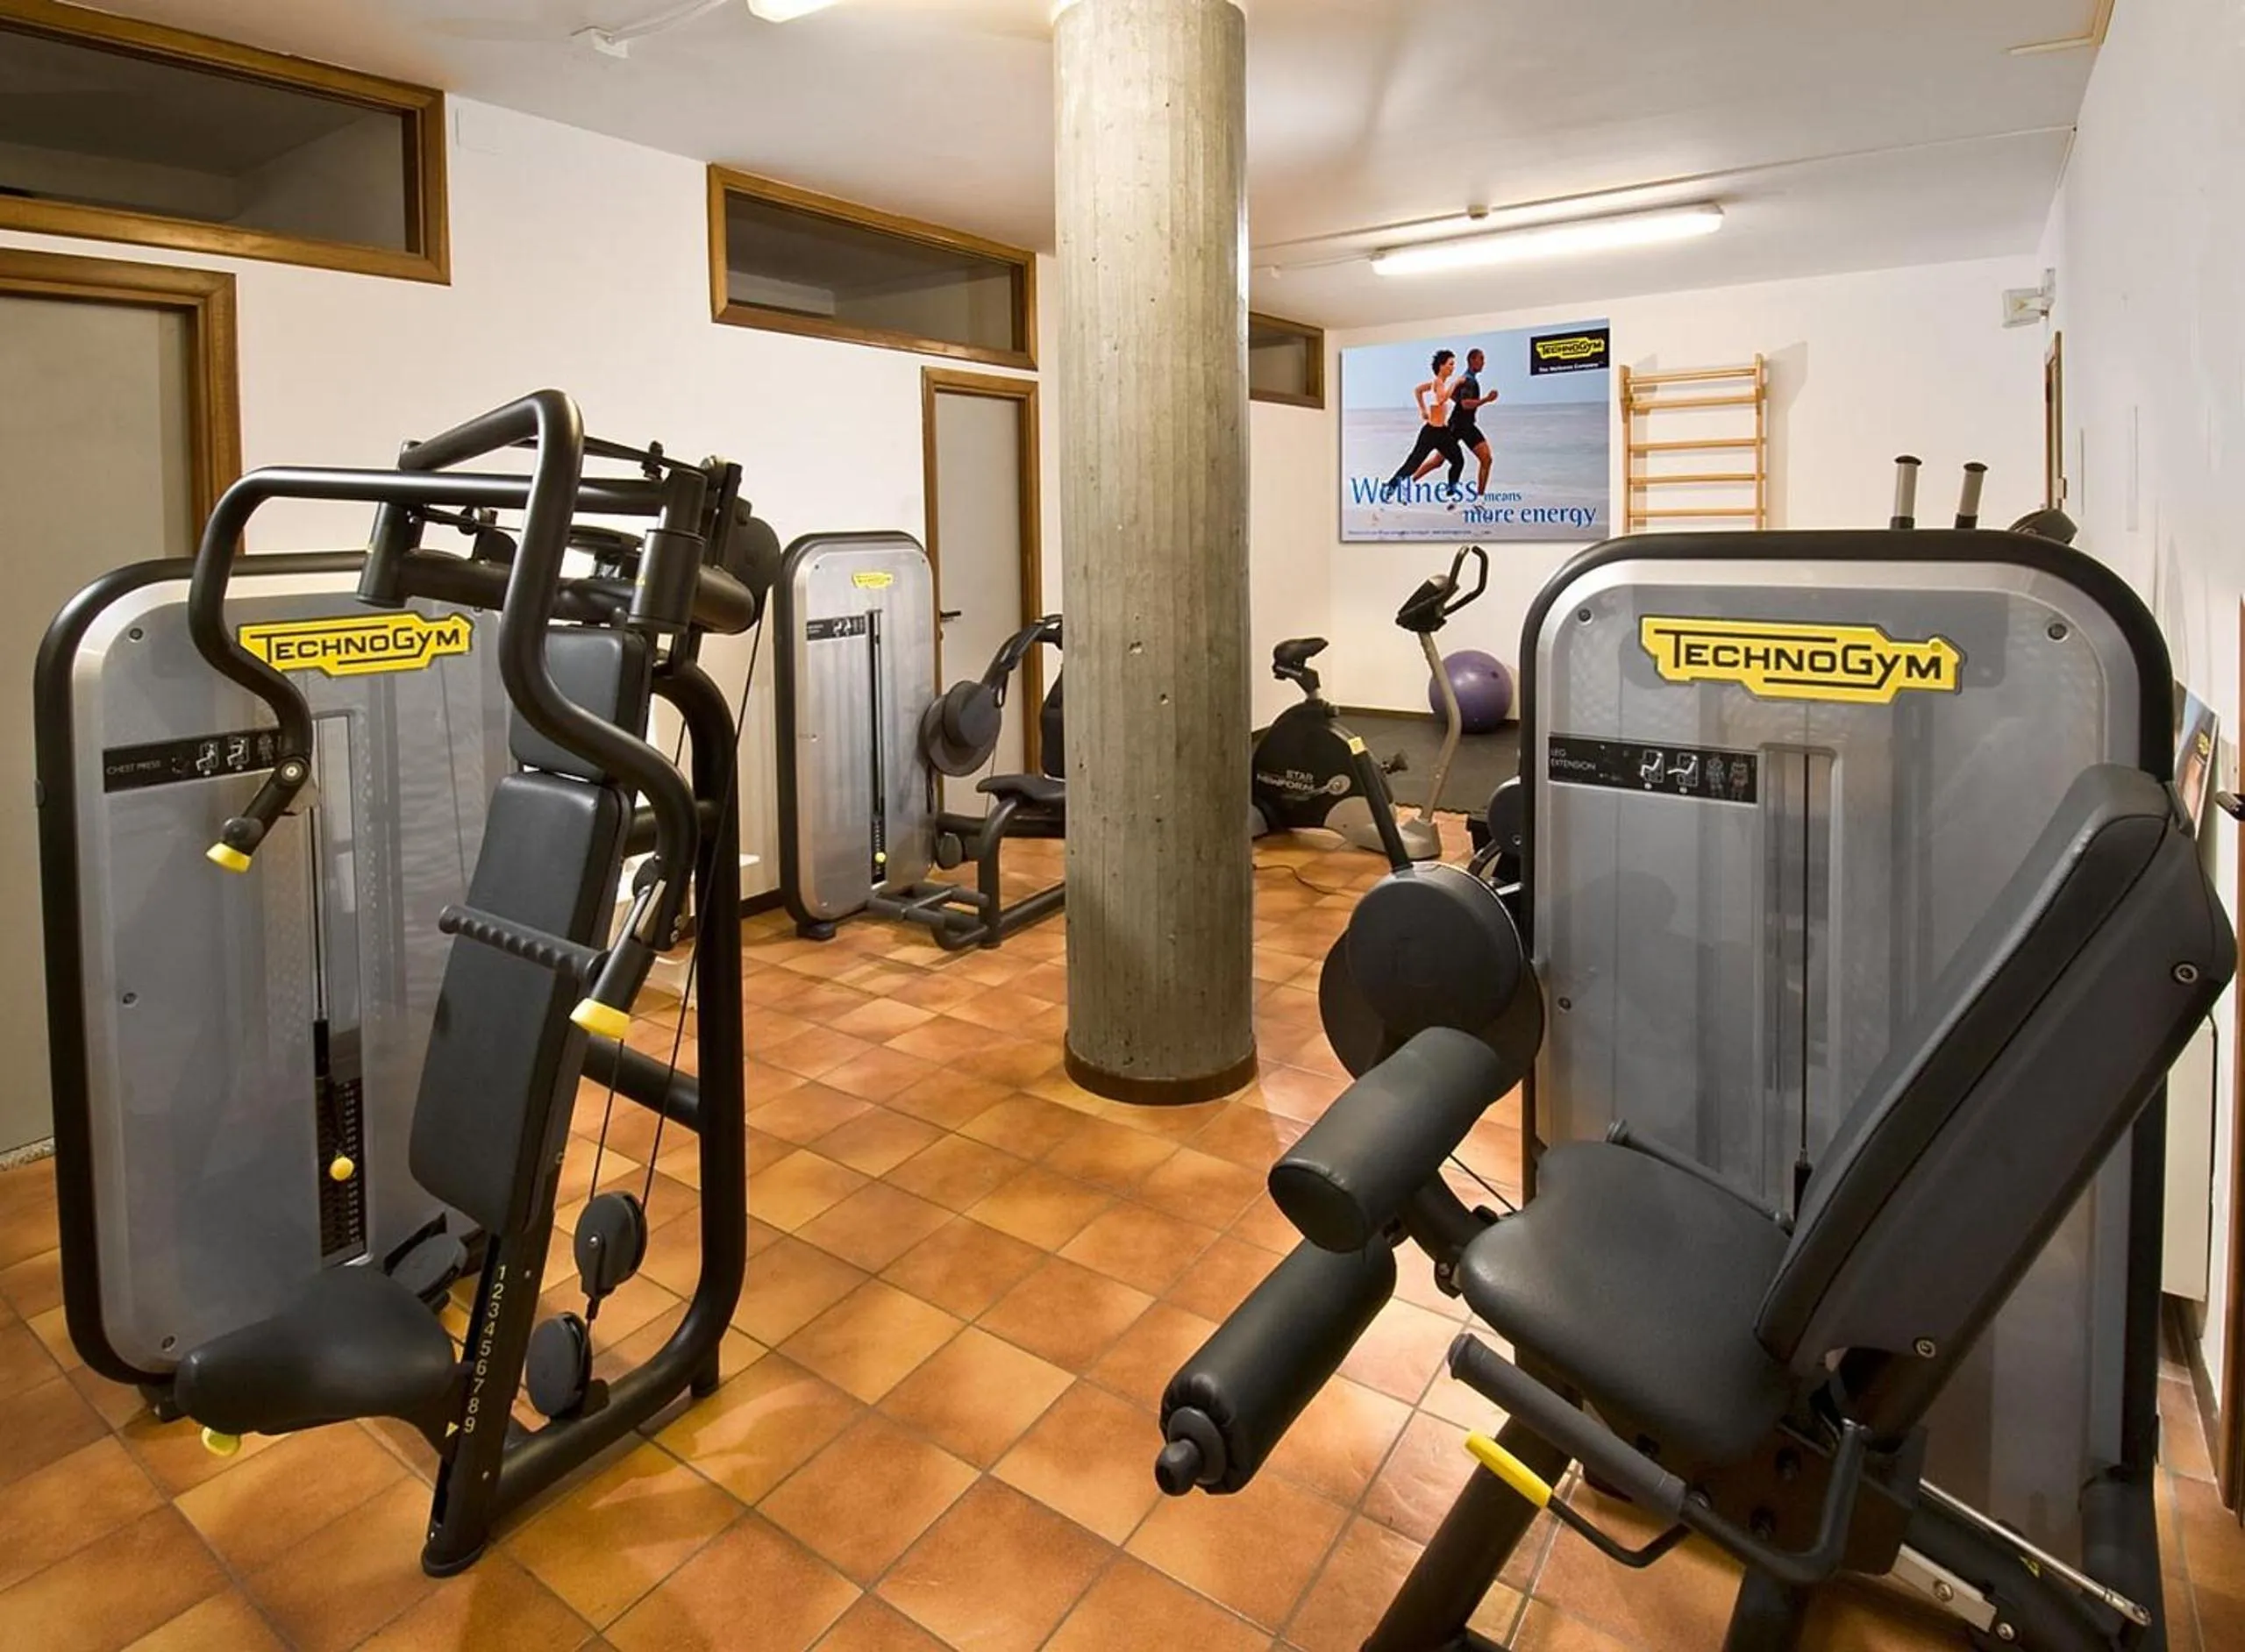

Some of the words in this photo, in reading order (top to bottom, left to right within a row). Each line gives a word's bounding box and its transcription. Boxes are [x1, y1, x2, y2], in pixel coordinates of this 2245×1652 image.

[1351, 476, 1479, 505] Wellness
[1484, 490, 1522, 502] means
[1464, 508, 1514, 523] more
[1521, 507, 1597, 527] energy
[1550, 758, 1597, 772] EXTENSION
